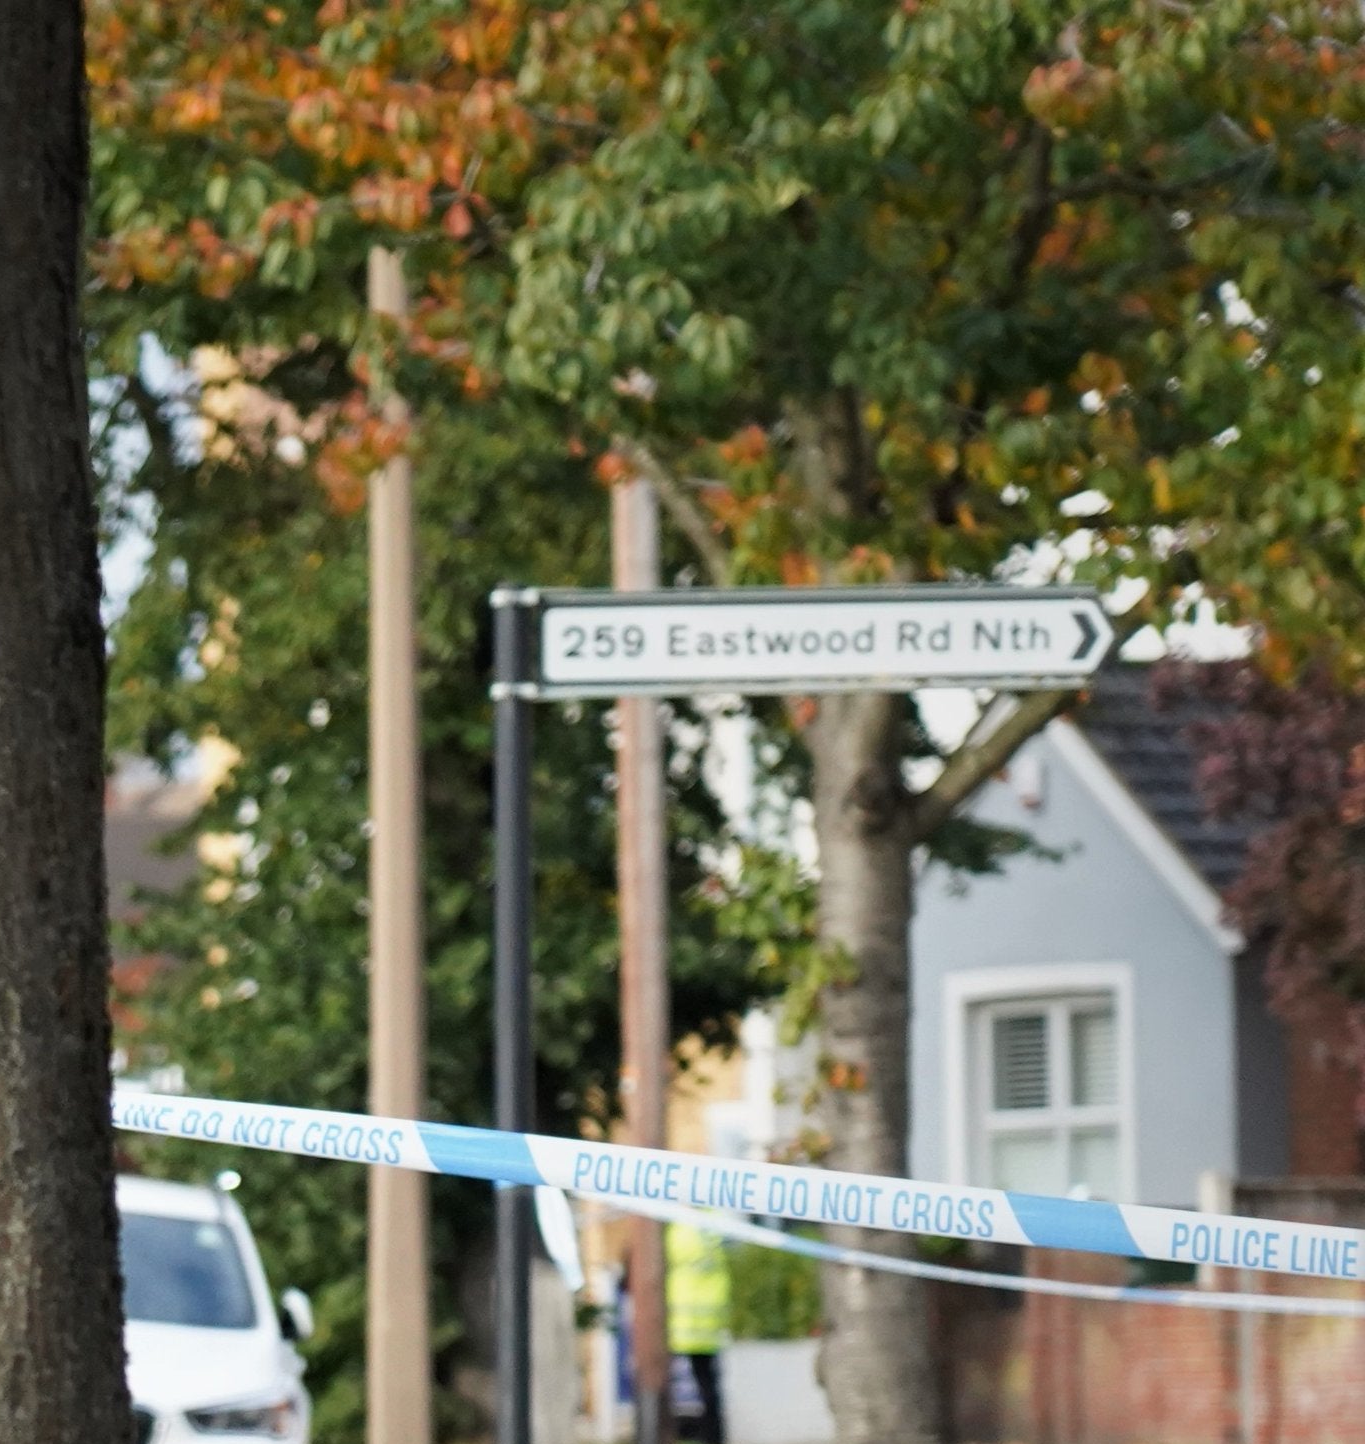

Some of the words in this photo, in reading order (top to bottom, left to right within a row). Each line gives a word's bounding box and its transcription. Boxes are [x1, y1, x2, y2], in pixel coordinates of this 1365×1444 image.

[563, 624, 646, 658] 259
[667, 620, 876, 657] Eastwood
[897, 619, 952, 653] Rd
[973, 617, 1053, 651] Nth
[181, 1110, 222, 1138] DO
[233, 1117, 295, 1148] NOT
[302, 1122, 403, 1164] CROSS
[573, 1152, 682, 1201] POLICE
[690, 1165, 758, 1211] LINE
[769, 1176, 810, 1218] DO
[820, 1182, 884, 1227] NOT
[892, 1190, 996, 1239] CROSS
[1171, 1222, 1280, 1269] POLICE
[1290, 1235, 1359, 1277] LINE
